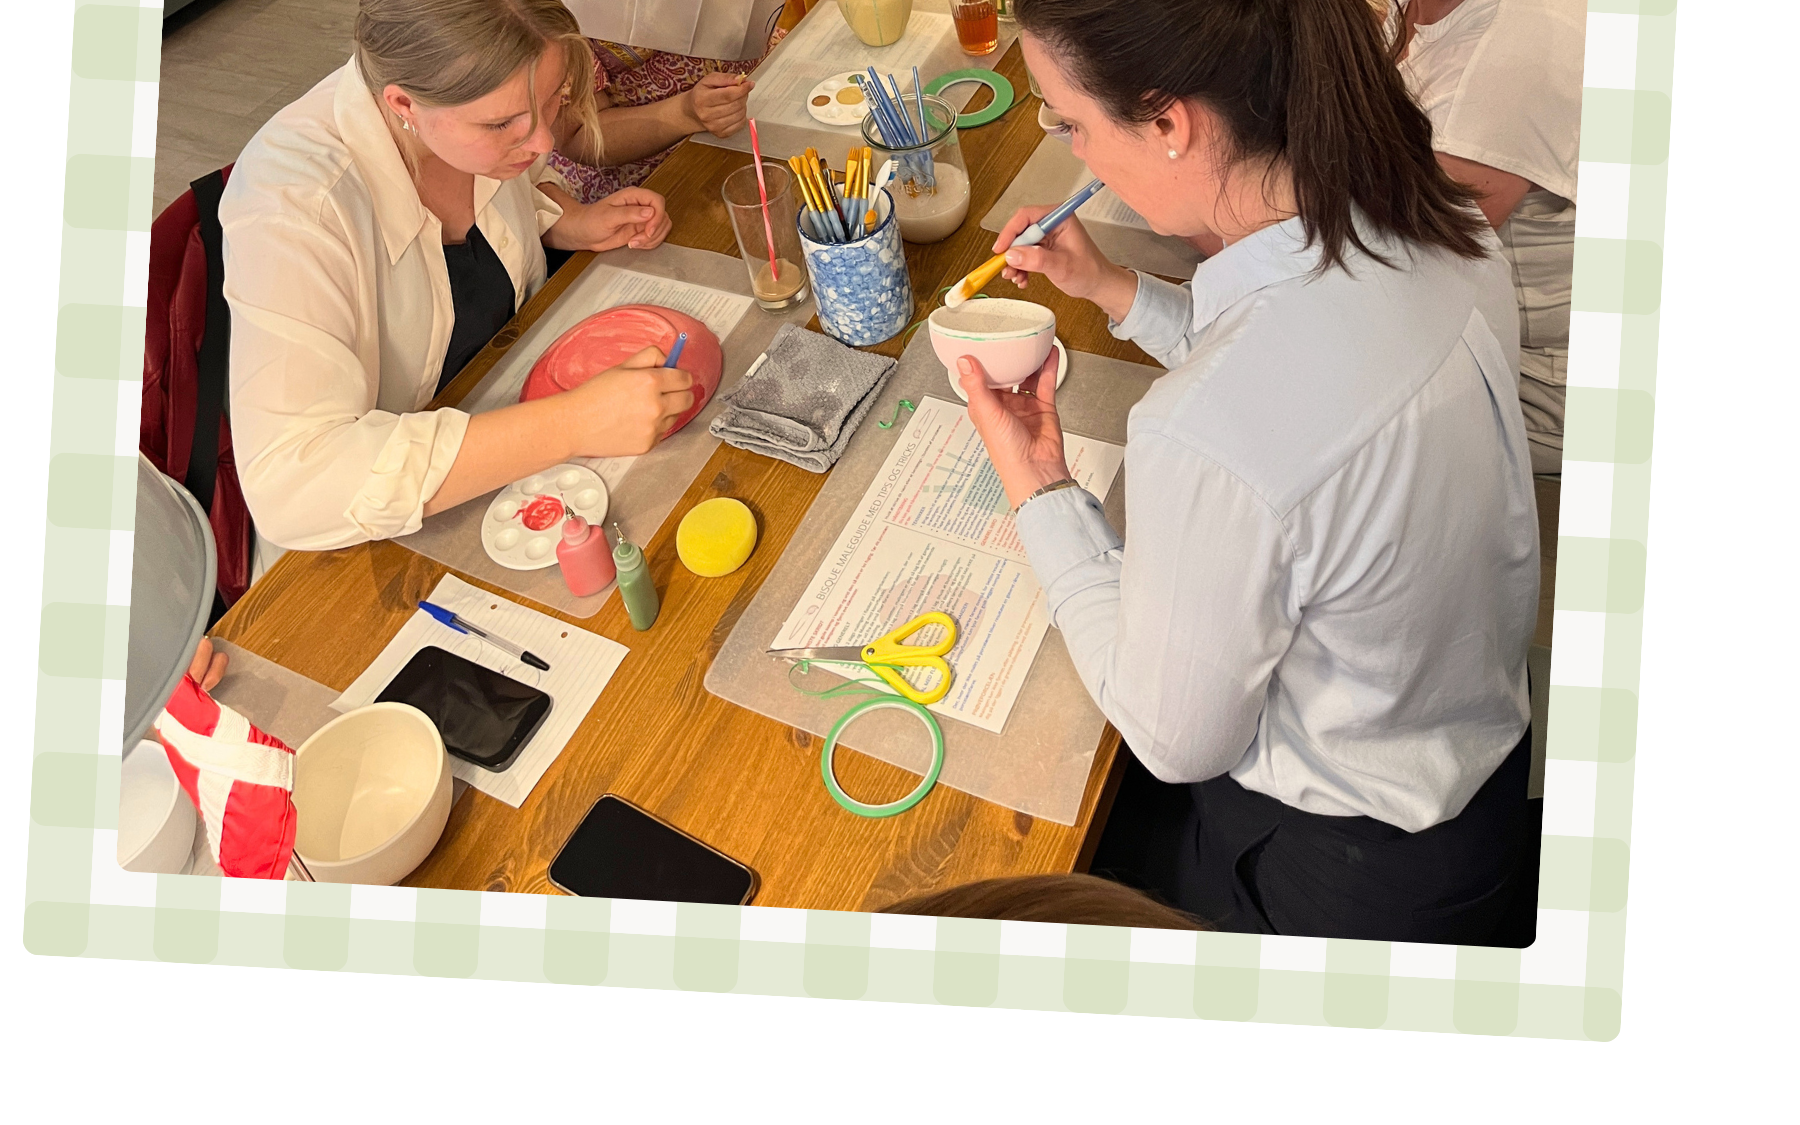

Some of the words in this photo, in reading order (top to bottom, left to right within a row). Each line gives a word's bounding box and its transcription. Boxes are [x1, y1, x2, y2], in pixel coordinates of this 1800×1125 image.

[815, 567, 842, 601] BISQUE
[835, 518, 871, 567] MALEGUIDE
[864, 499, 882, 518] MED
[876, 481, 893, 498] TIPS
[895, 442, 917, 468] TRICKS
